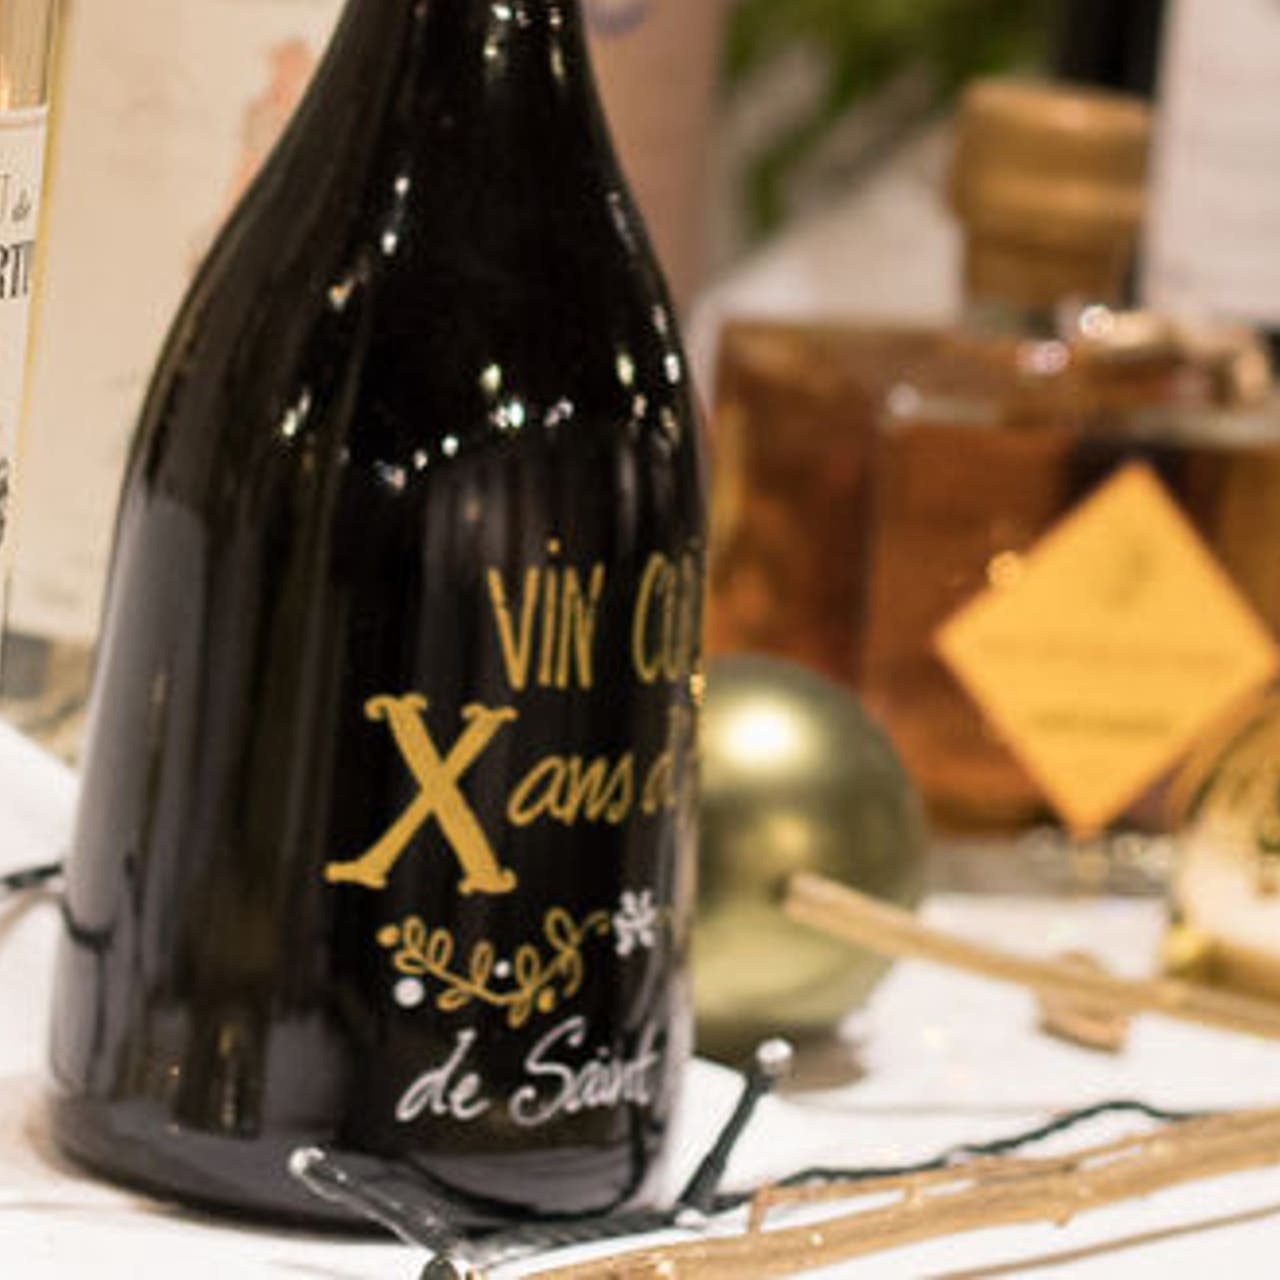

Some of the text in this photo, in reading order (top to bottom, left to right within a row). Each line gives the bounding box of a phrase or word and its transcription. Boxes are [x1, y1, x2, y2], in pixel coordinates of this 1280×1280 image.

[324, 691, 519, 895] X
[508, 752, 633, 827] ans
[396, 1028, 490, 1122] de
